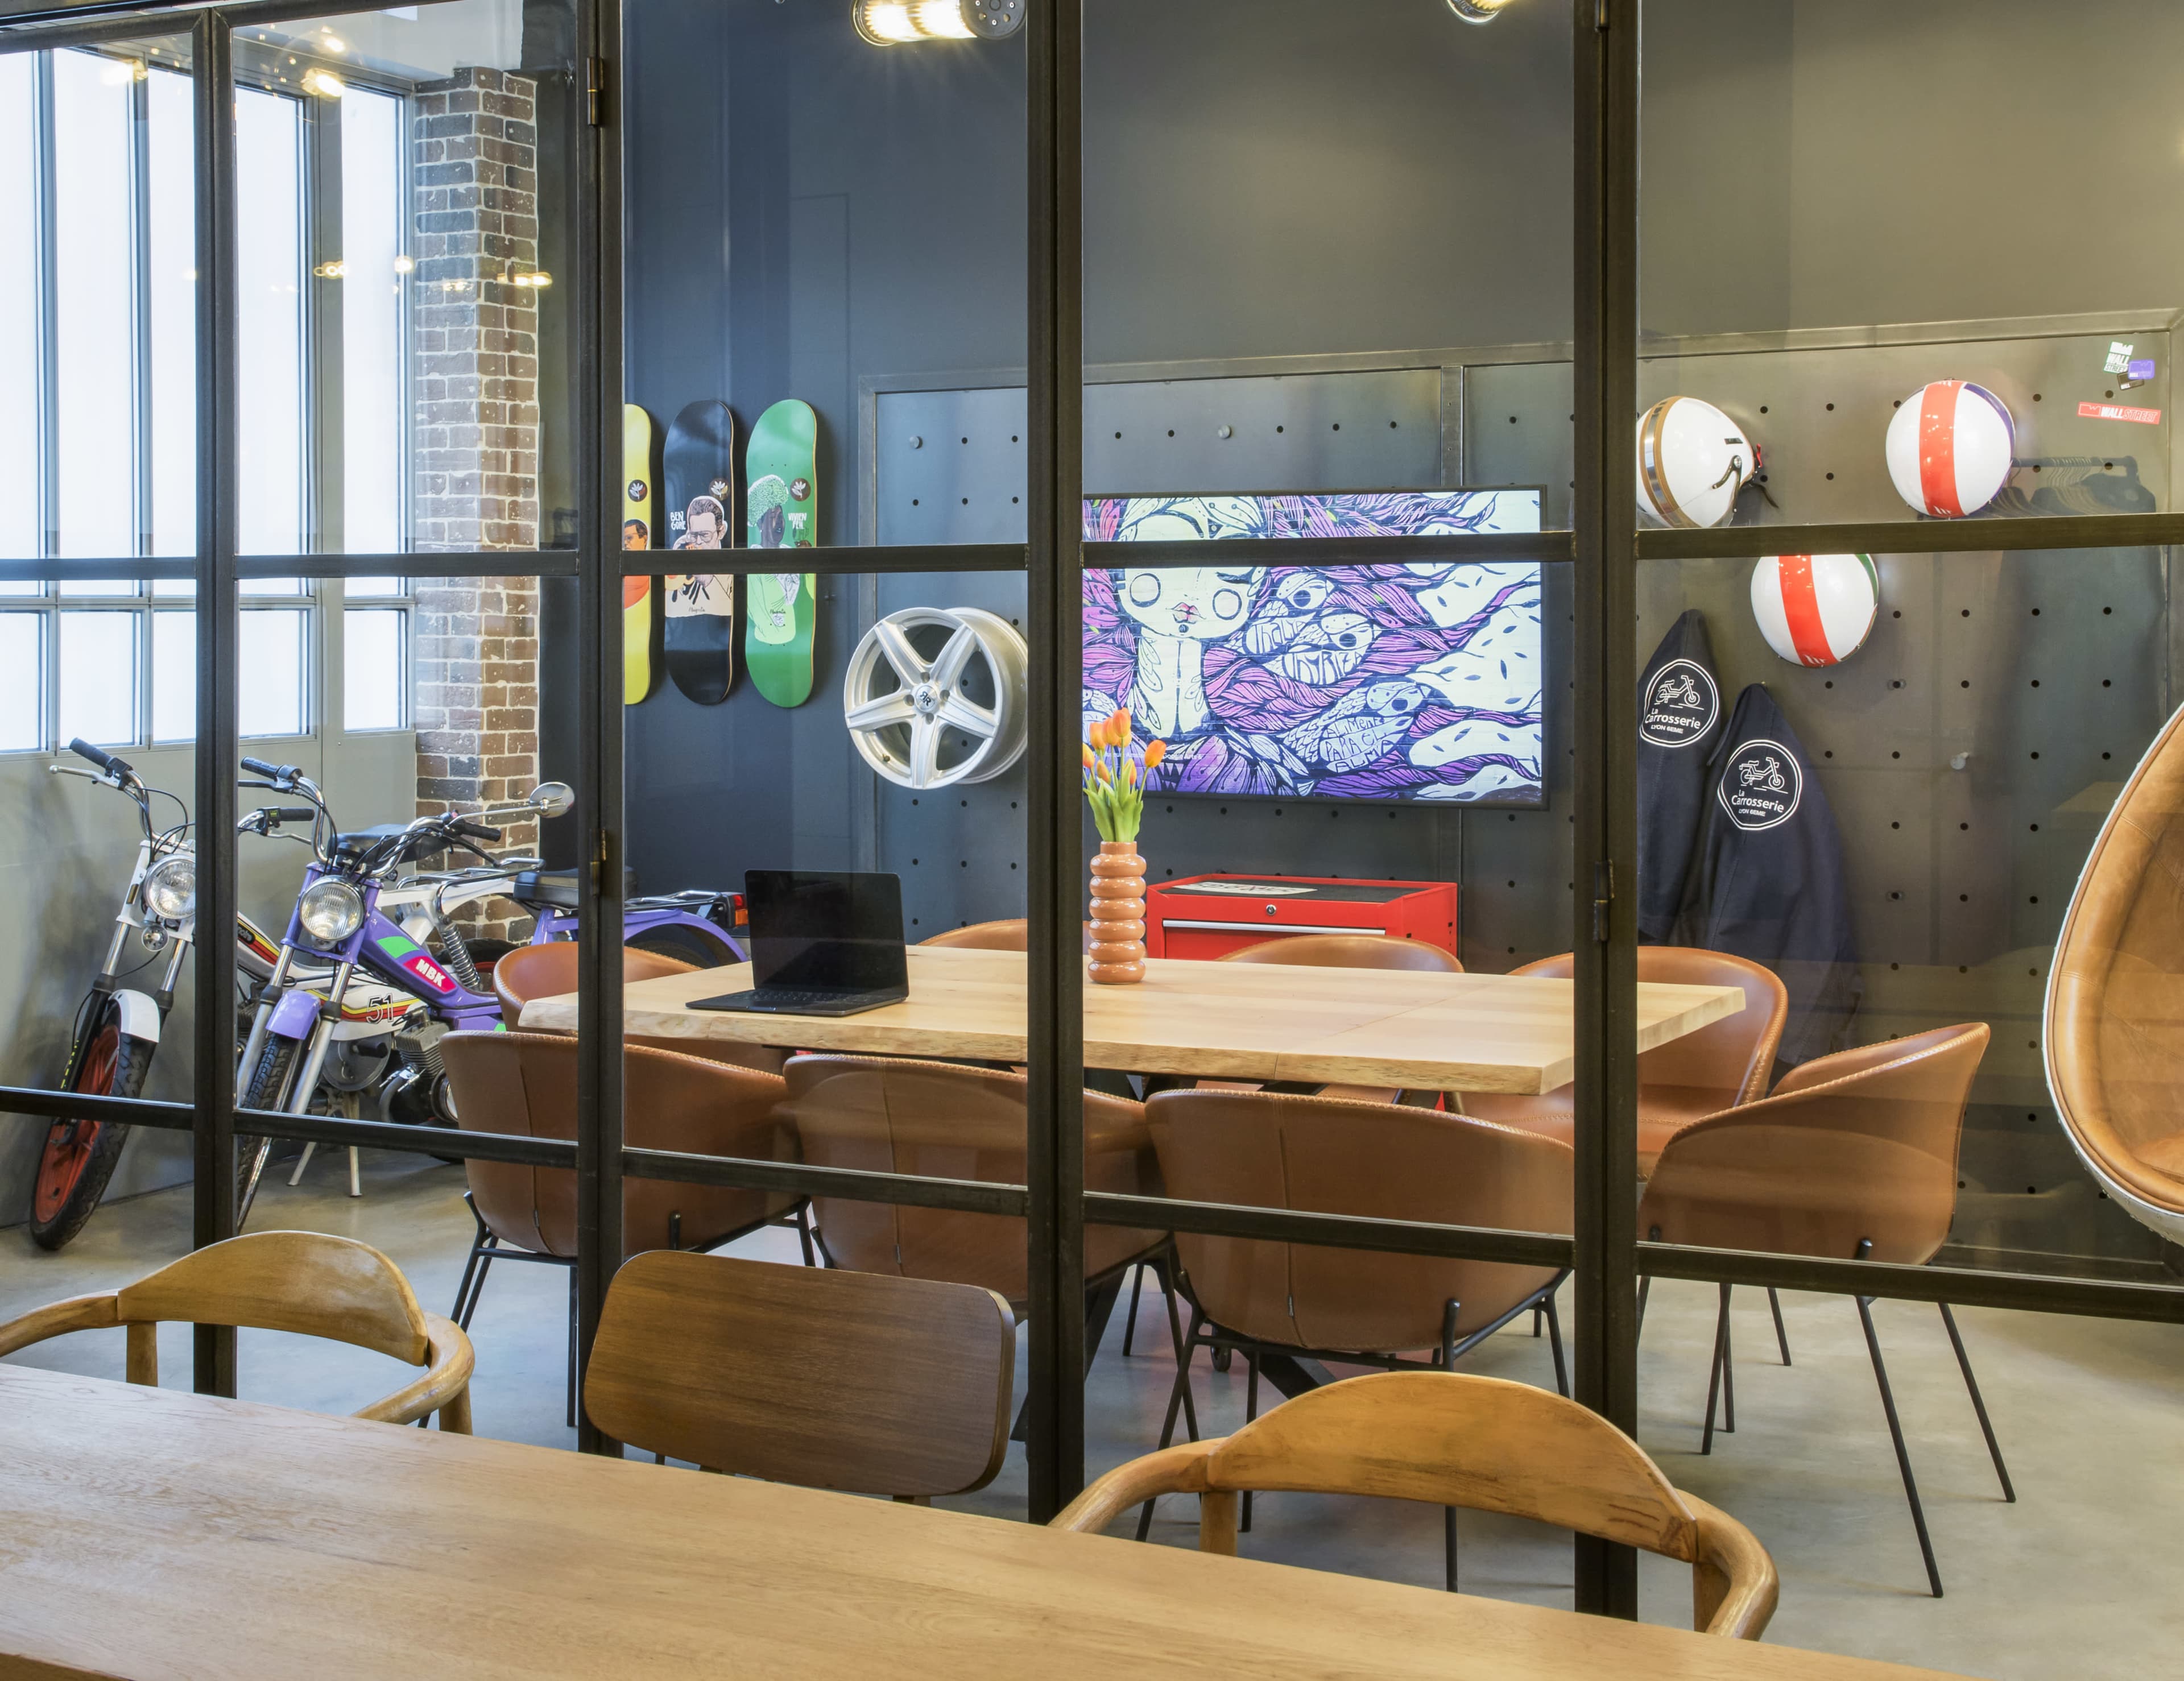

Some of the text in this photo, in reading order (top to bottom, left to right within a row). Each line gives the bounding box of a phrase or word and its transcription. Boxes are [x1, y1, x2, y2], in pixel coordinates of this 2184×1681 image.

[2101, 406, 2158, 423] WALL STREET
[670, 511, 684, 521] BEN
[1645, 714, 1701, 730] Carrosserie
[1731, 795, 1784, 813] Carrosserie
[415, 959, 446, 988] MBK
[366, 992, 394, 1024] 51
